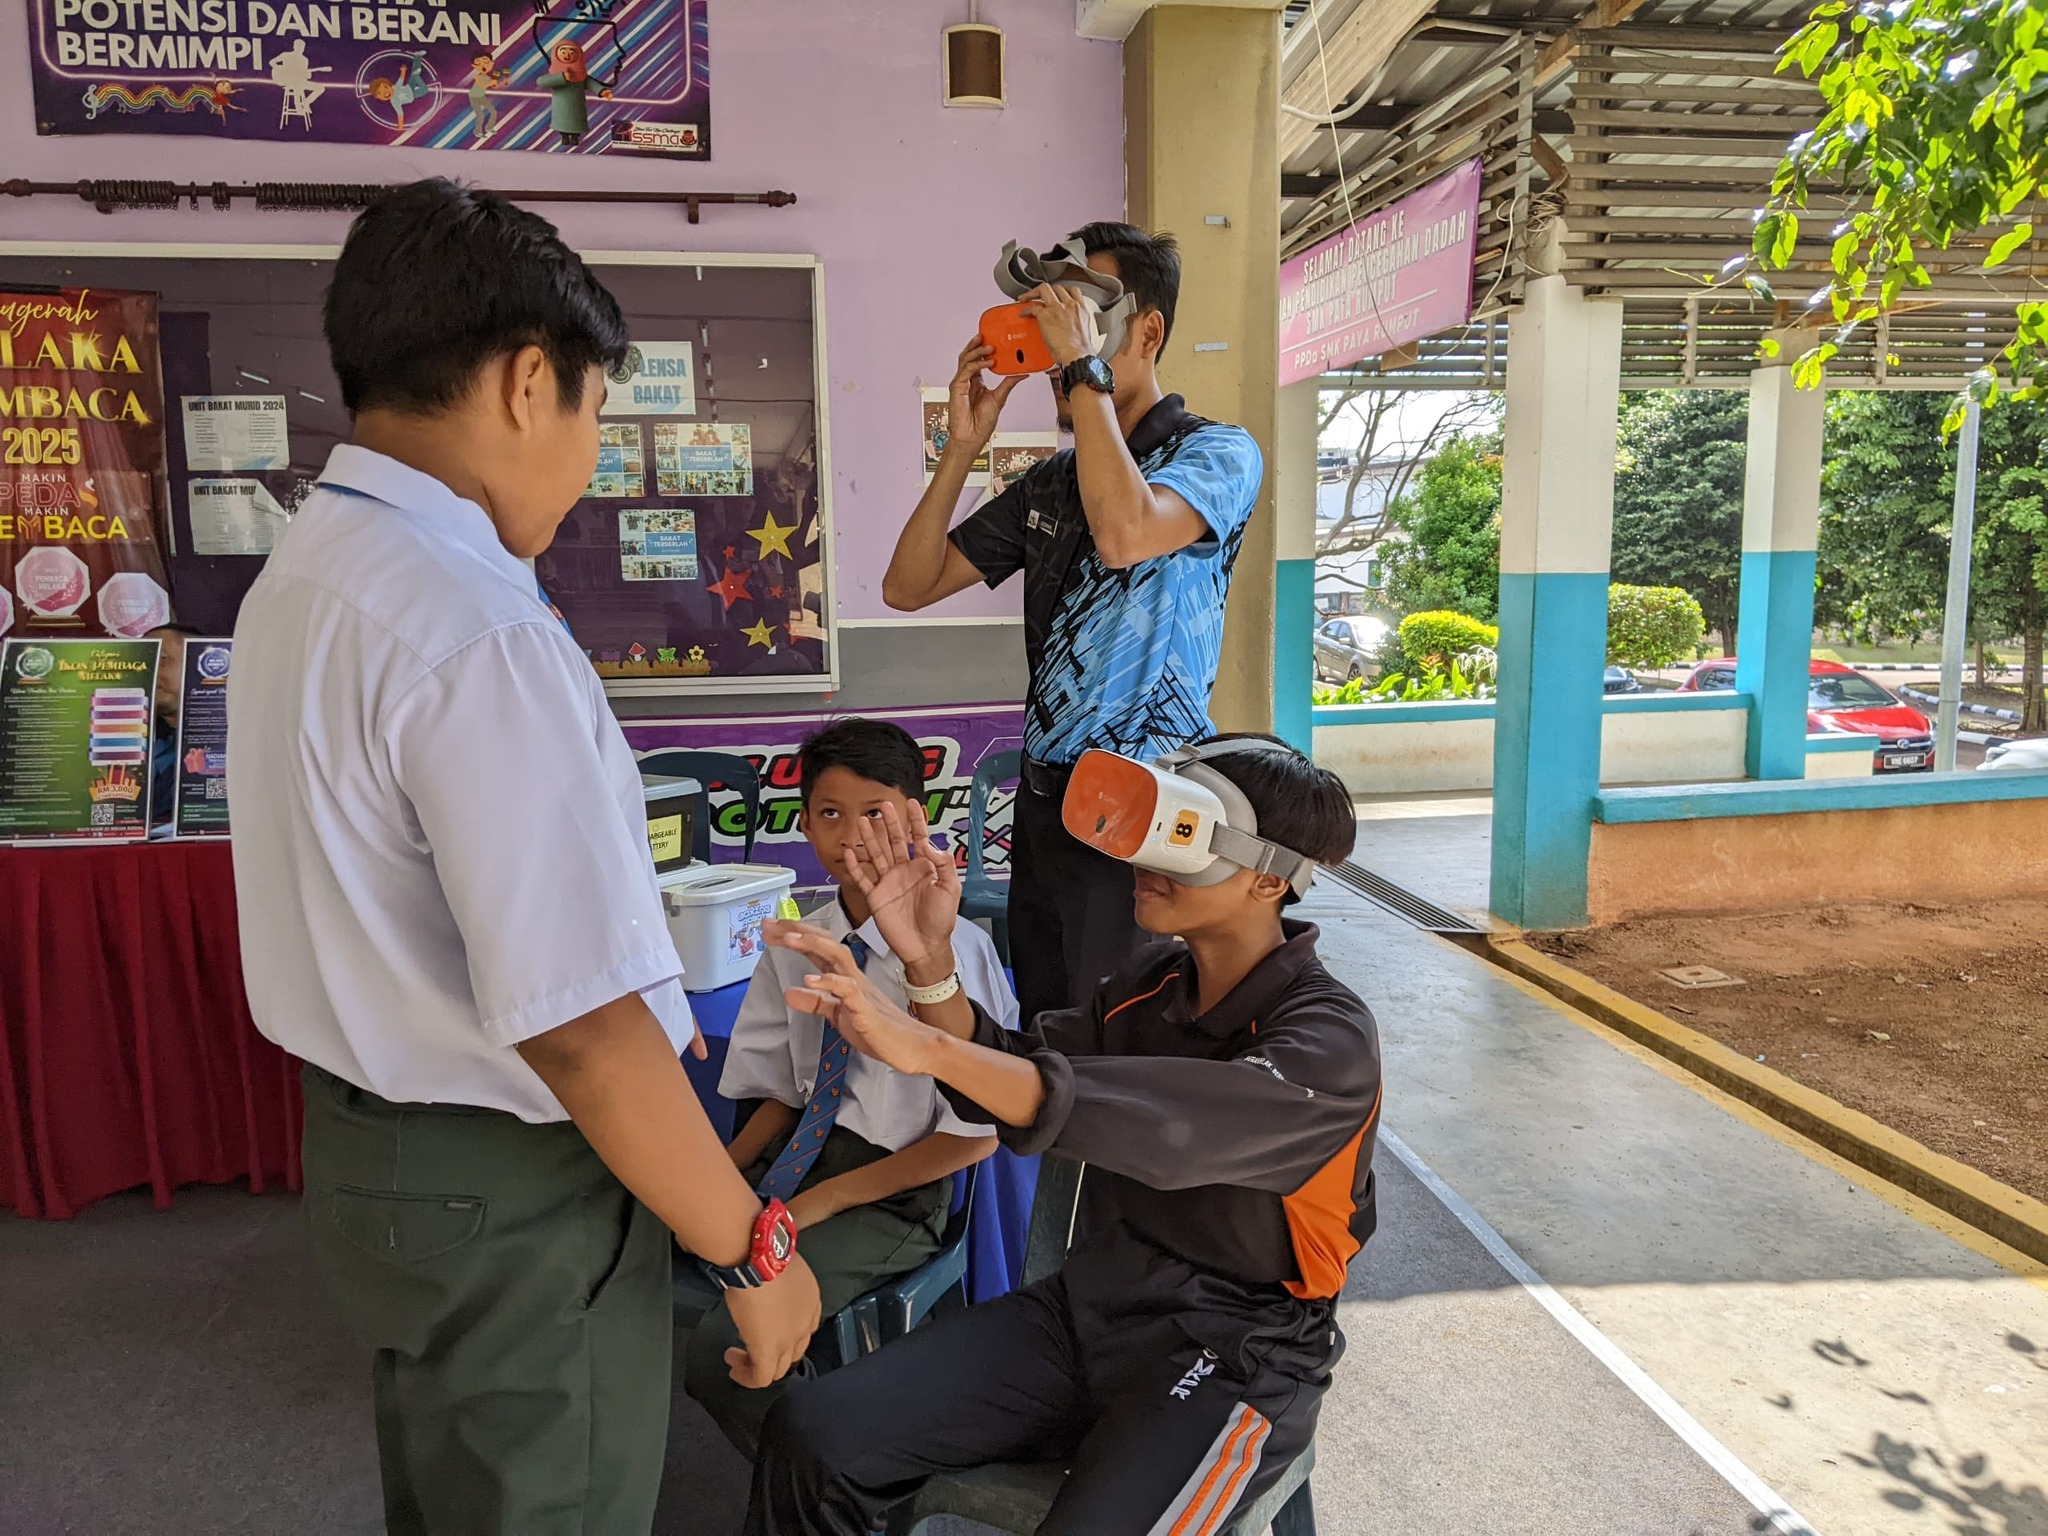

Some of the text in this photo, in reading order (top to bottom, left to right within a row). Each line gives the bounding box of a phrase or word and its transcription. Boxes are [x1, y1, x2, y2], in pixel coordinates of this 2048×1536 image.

[56, 0, 500, 46] POTENSI DAN BERANI
[57, 31, 263, 71] BERMIMPI
[1304, 209, 1404, 286] SELAMAT DATANG KE
[1295, 264, 1350, 314] PENDIDIKAN
[1351, 231, 1418, 290] PENCEGAHAN
[1424, 210, 1466, 257] DADAH
[0, 289, 98, 338] ugerah
[1306, 304, 1324, 335] SMK
[1320, 339, 1341, 360] SMK
[1343, 328, 1370, 352] PAYA
[1373, 308, 1420, 341] RUMPUT
[0, 330, 144, 373] LAKA
[639, 358, 686, 378] LENSA
[0, 386, 151, 424] MBACA
[189, 400, 285, 412] UNIT BAKAT MURID 2024
[633, 384, 681, 405] BAKAT
[3, 428, 80, 464] 2025
[22, 473, 66, 482] MAKIN
[194, 485, 210, 495] UNIT
[213, 485, 238, 495] BAKAT
[25, 507, 69, 516] MAKIN
[0, 515, 128, 539] EMBACA
[650, 829, 677, 839] ARGEABLE
[1175, 822, 1193, 838] 8
[652, 841, 668, 850] TTERY
